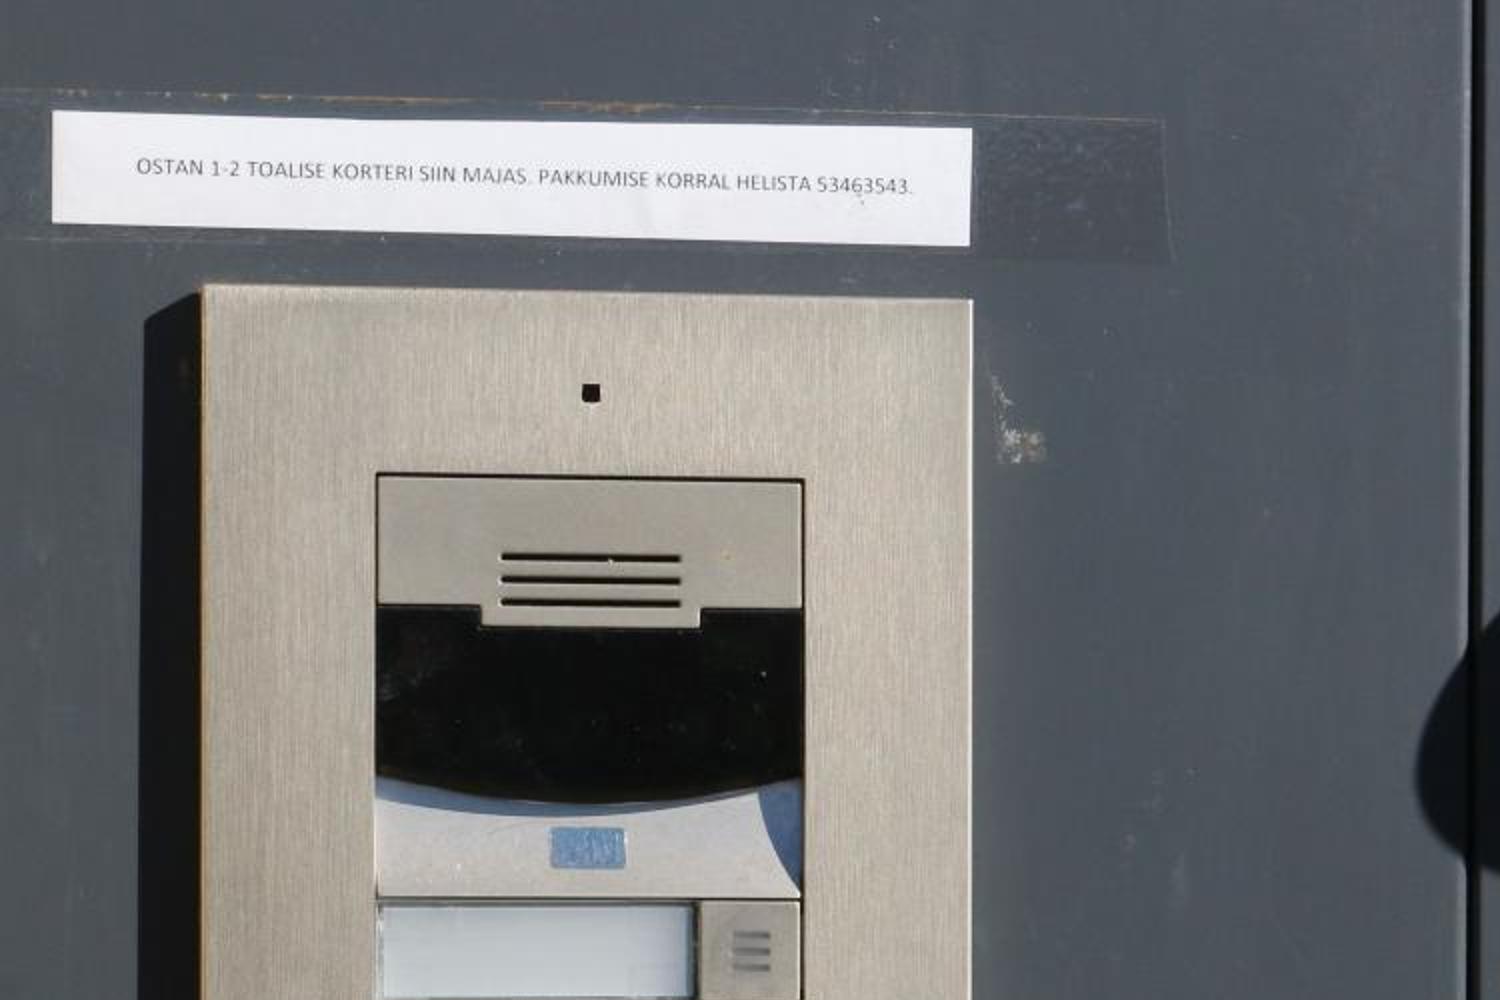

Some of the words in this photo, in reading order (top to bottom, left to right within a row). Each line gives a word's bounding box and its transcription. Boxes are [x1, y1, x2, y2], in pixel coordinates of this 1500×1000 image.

[136, 157, 203, 176] OSTAN
[211, 160, 240, 177] 1-2
[246, 161, 324, 179] TOALISE
[331, 163, 413, 181] KORTERI
[418, 165, 456, 182] SIIN
[538, 169, 649, 188] PAKKUMISE
[655, 173, 730, 190] KORRAL
[736, 175, 811, 192] HELISTA
[816, 176, 913, 194] 53463543.
